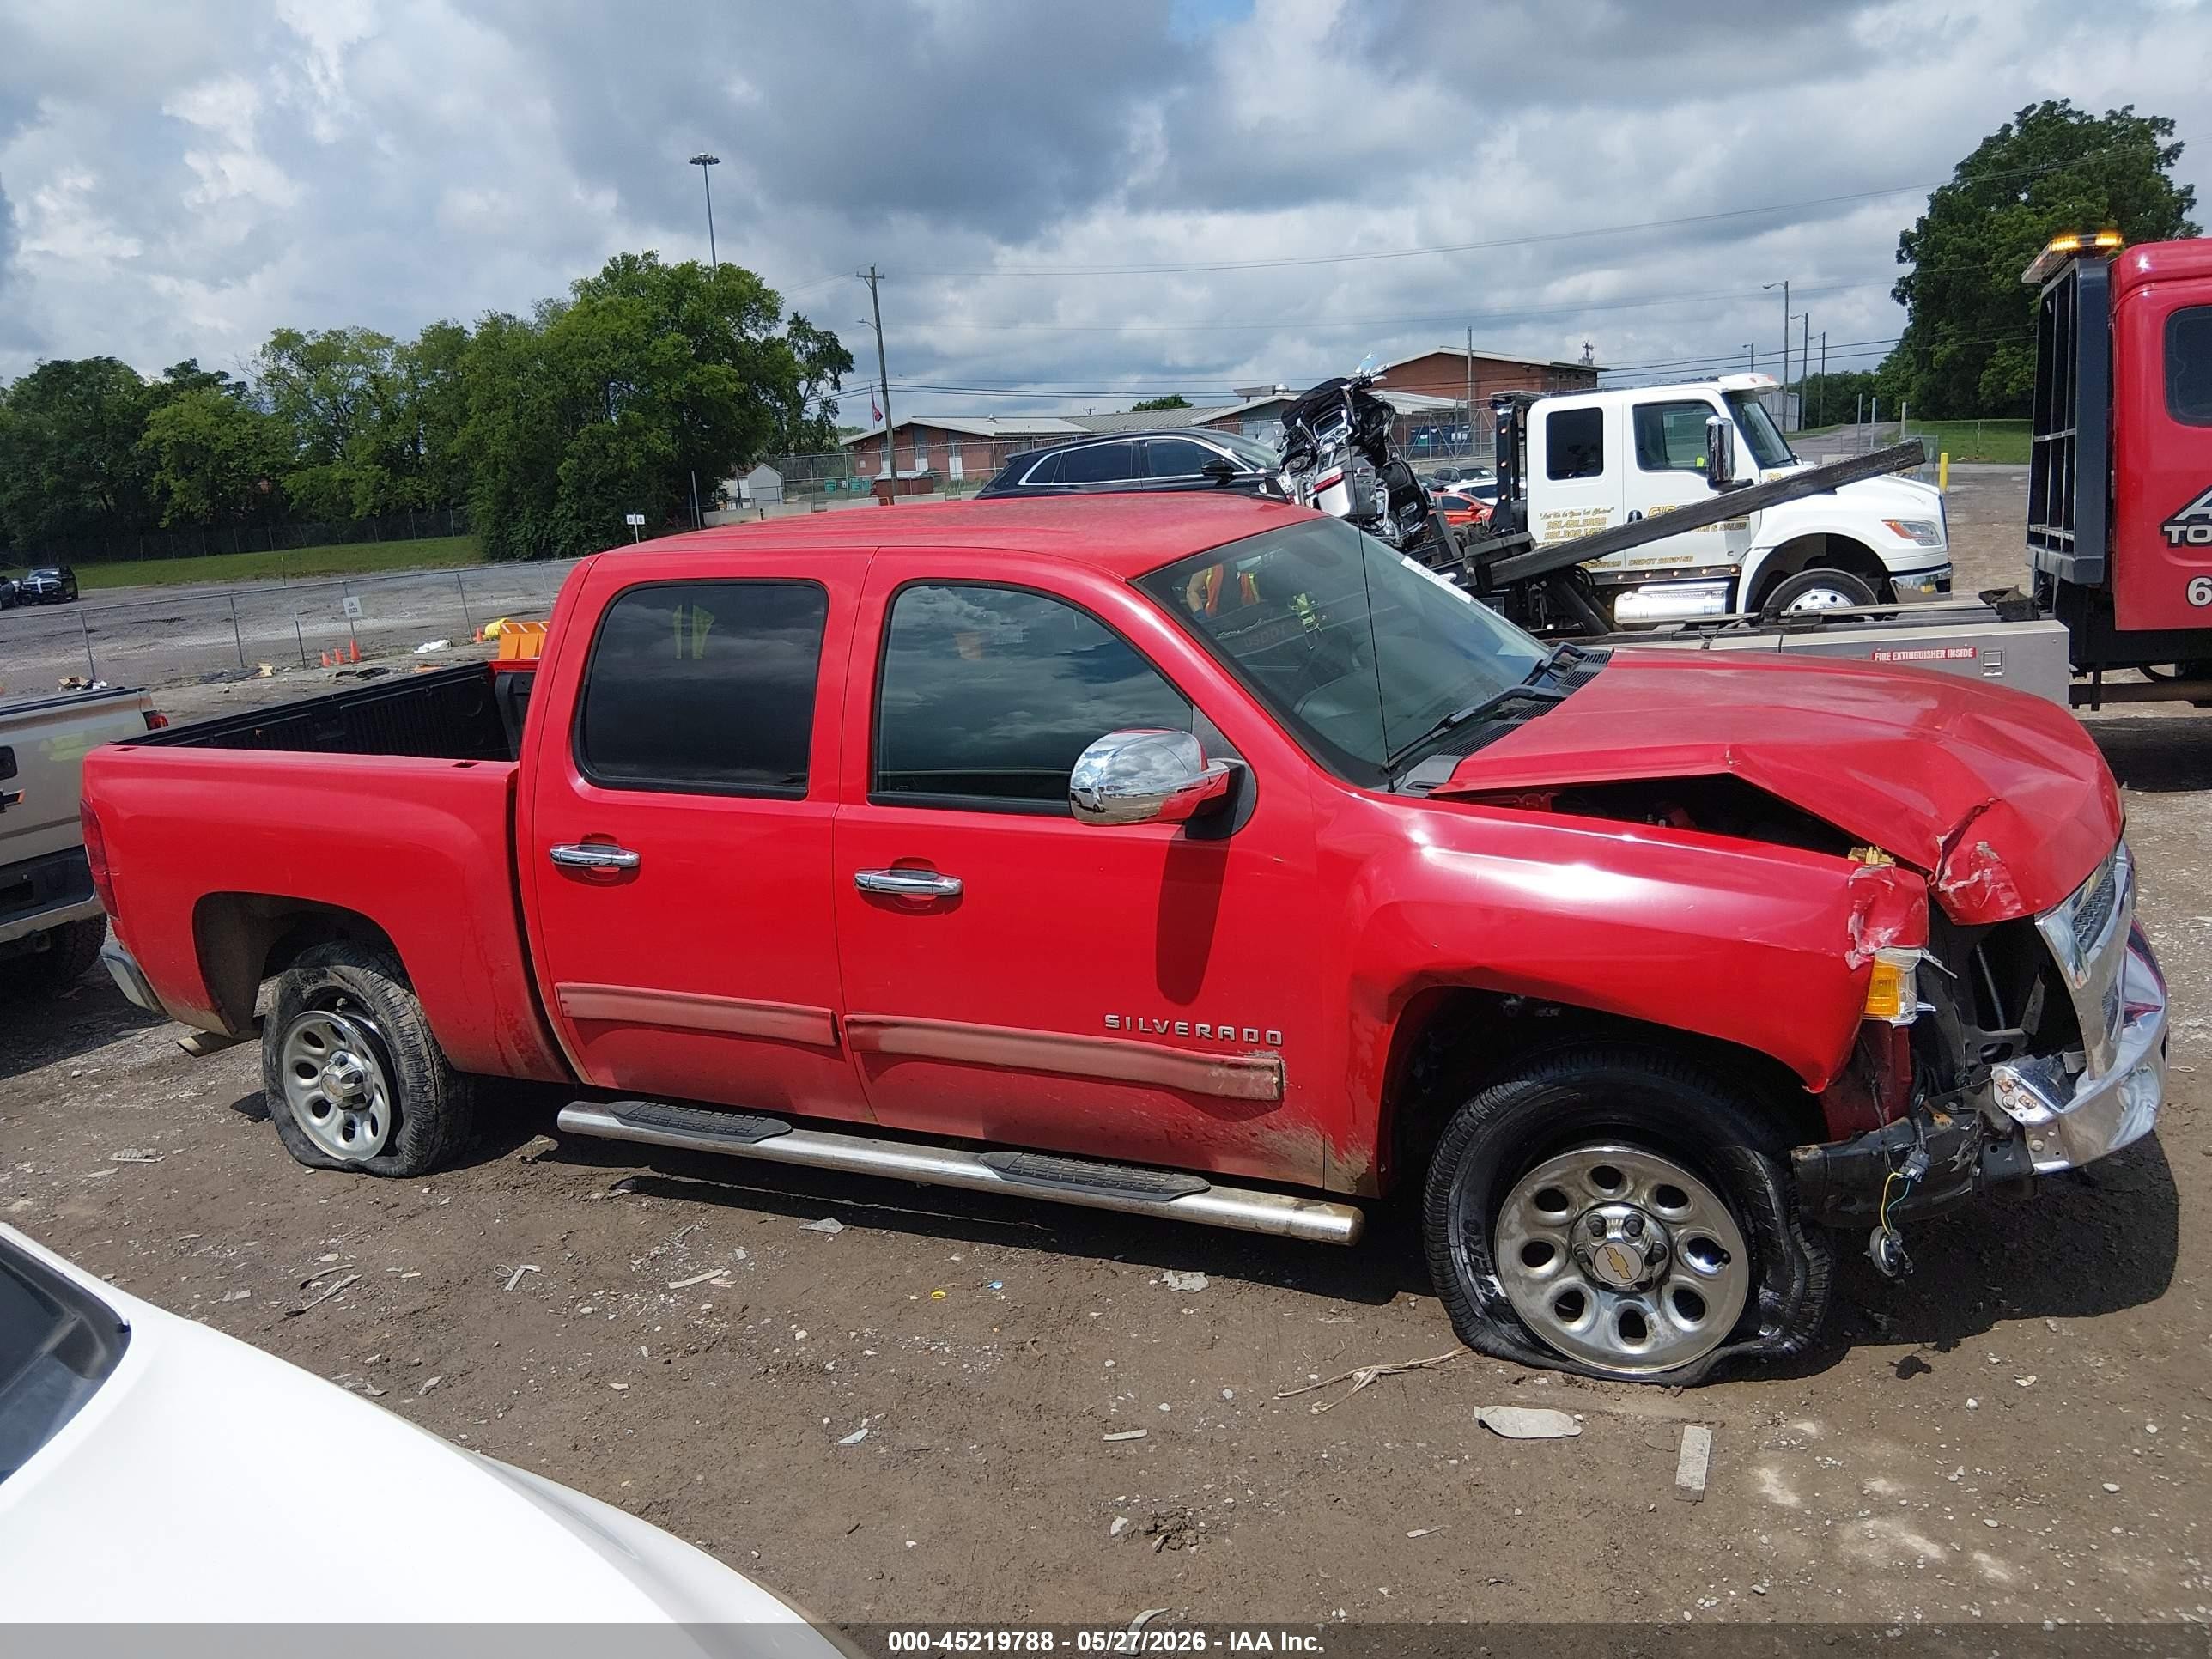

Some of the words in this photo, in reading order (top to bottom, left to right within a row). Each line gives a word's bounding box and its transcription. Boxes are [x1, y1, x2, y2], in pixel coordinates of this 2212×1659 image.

[1719, 521, 1747, 531] SALES
[1874, 652, 1892, 661] FIRE
[1892, 649, 1946, 660] EXTINGUISHER
[1947, 647, 1973, 659] INSIDE
[1104, 1014, 1284, 1046] SILVERADO
